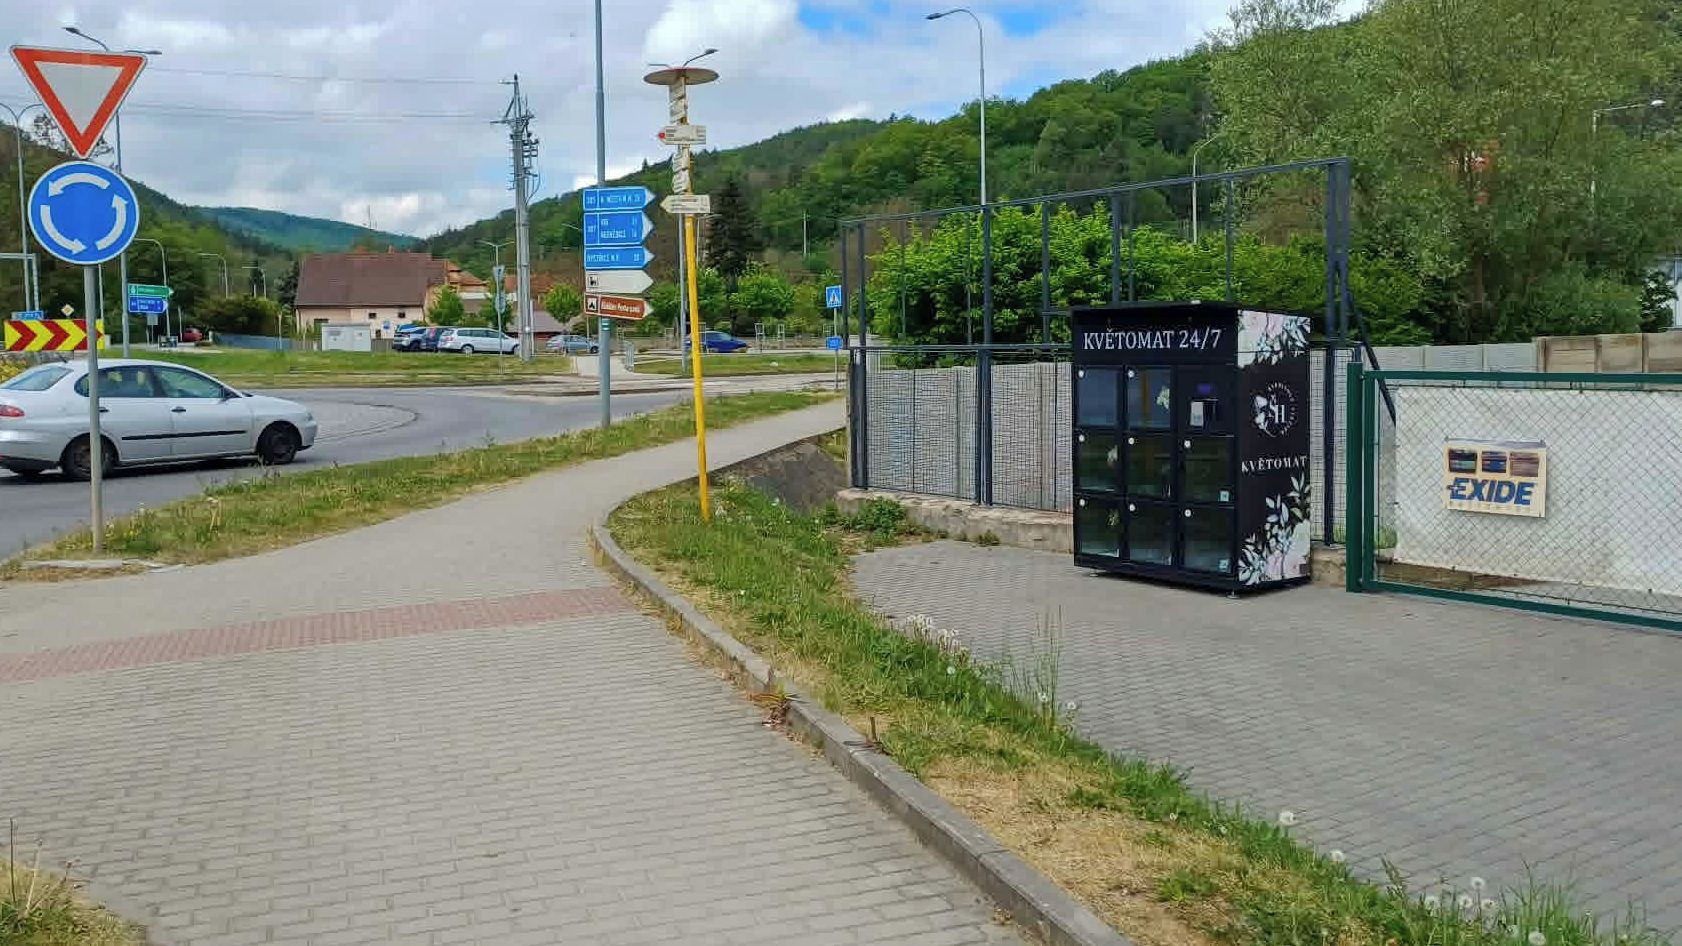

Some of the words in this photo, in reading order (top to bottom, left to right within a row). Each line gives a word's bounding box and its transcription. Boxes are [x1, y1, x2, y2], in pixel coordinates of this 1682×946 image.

[1083, 328, 1175, 350] KVĚTOMAT
[1179, 326, 1222, 350] 24/7
[1241, 455, 1307, 473] KVĚTOMAT
[1447, 477, 1535, 505] EXIDE
